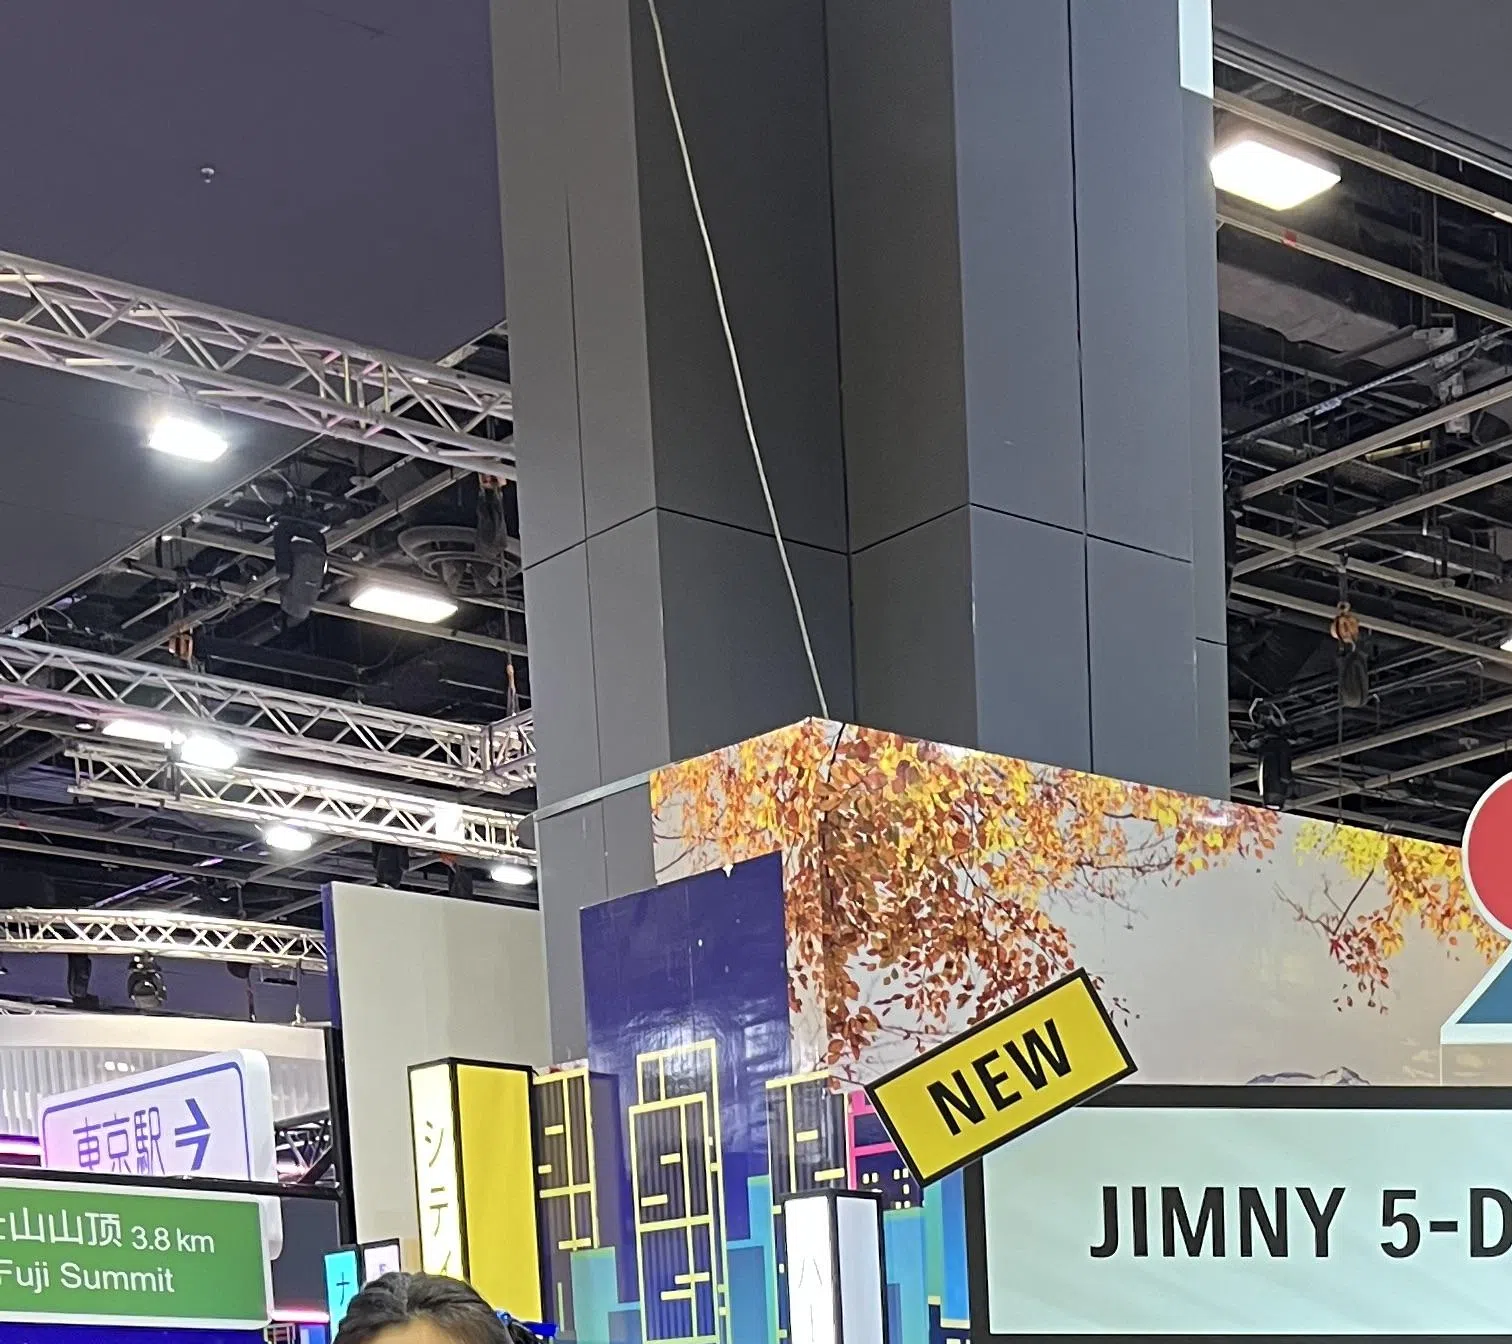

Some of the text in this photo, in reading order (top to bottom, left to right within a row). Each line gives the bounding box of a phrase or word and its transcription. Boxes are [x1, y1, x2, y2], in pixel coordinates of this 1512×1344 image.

[926, 1017, 1073, 1137] NEW
[72, 1106, 166, 1175] 東京駅
[0, 1207, 215, 1253] 山山顶 3.8 km
[1089, 1185, 1346, 1258] JIMNY
[0, 1259, 175, 1294] Fuji Summit
